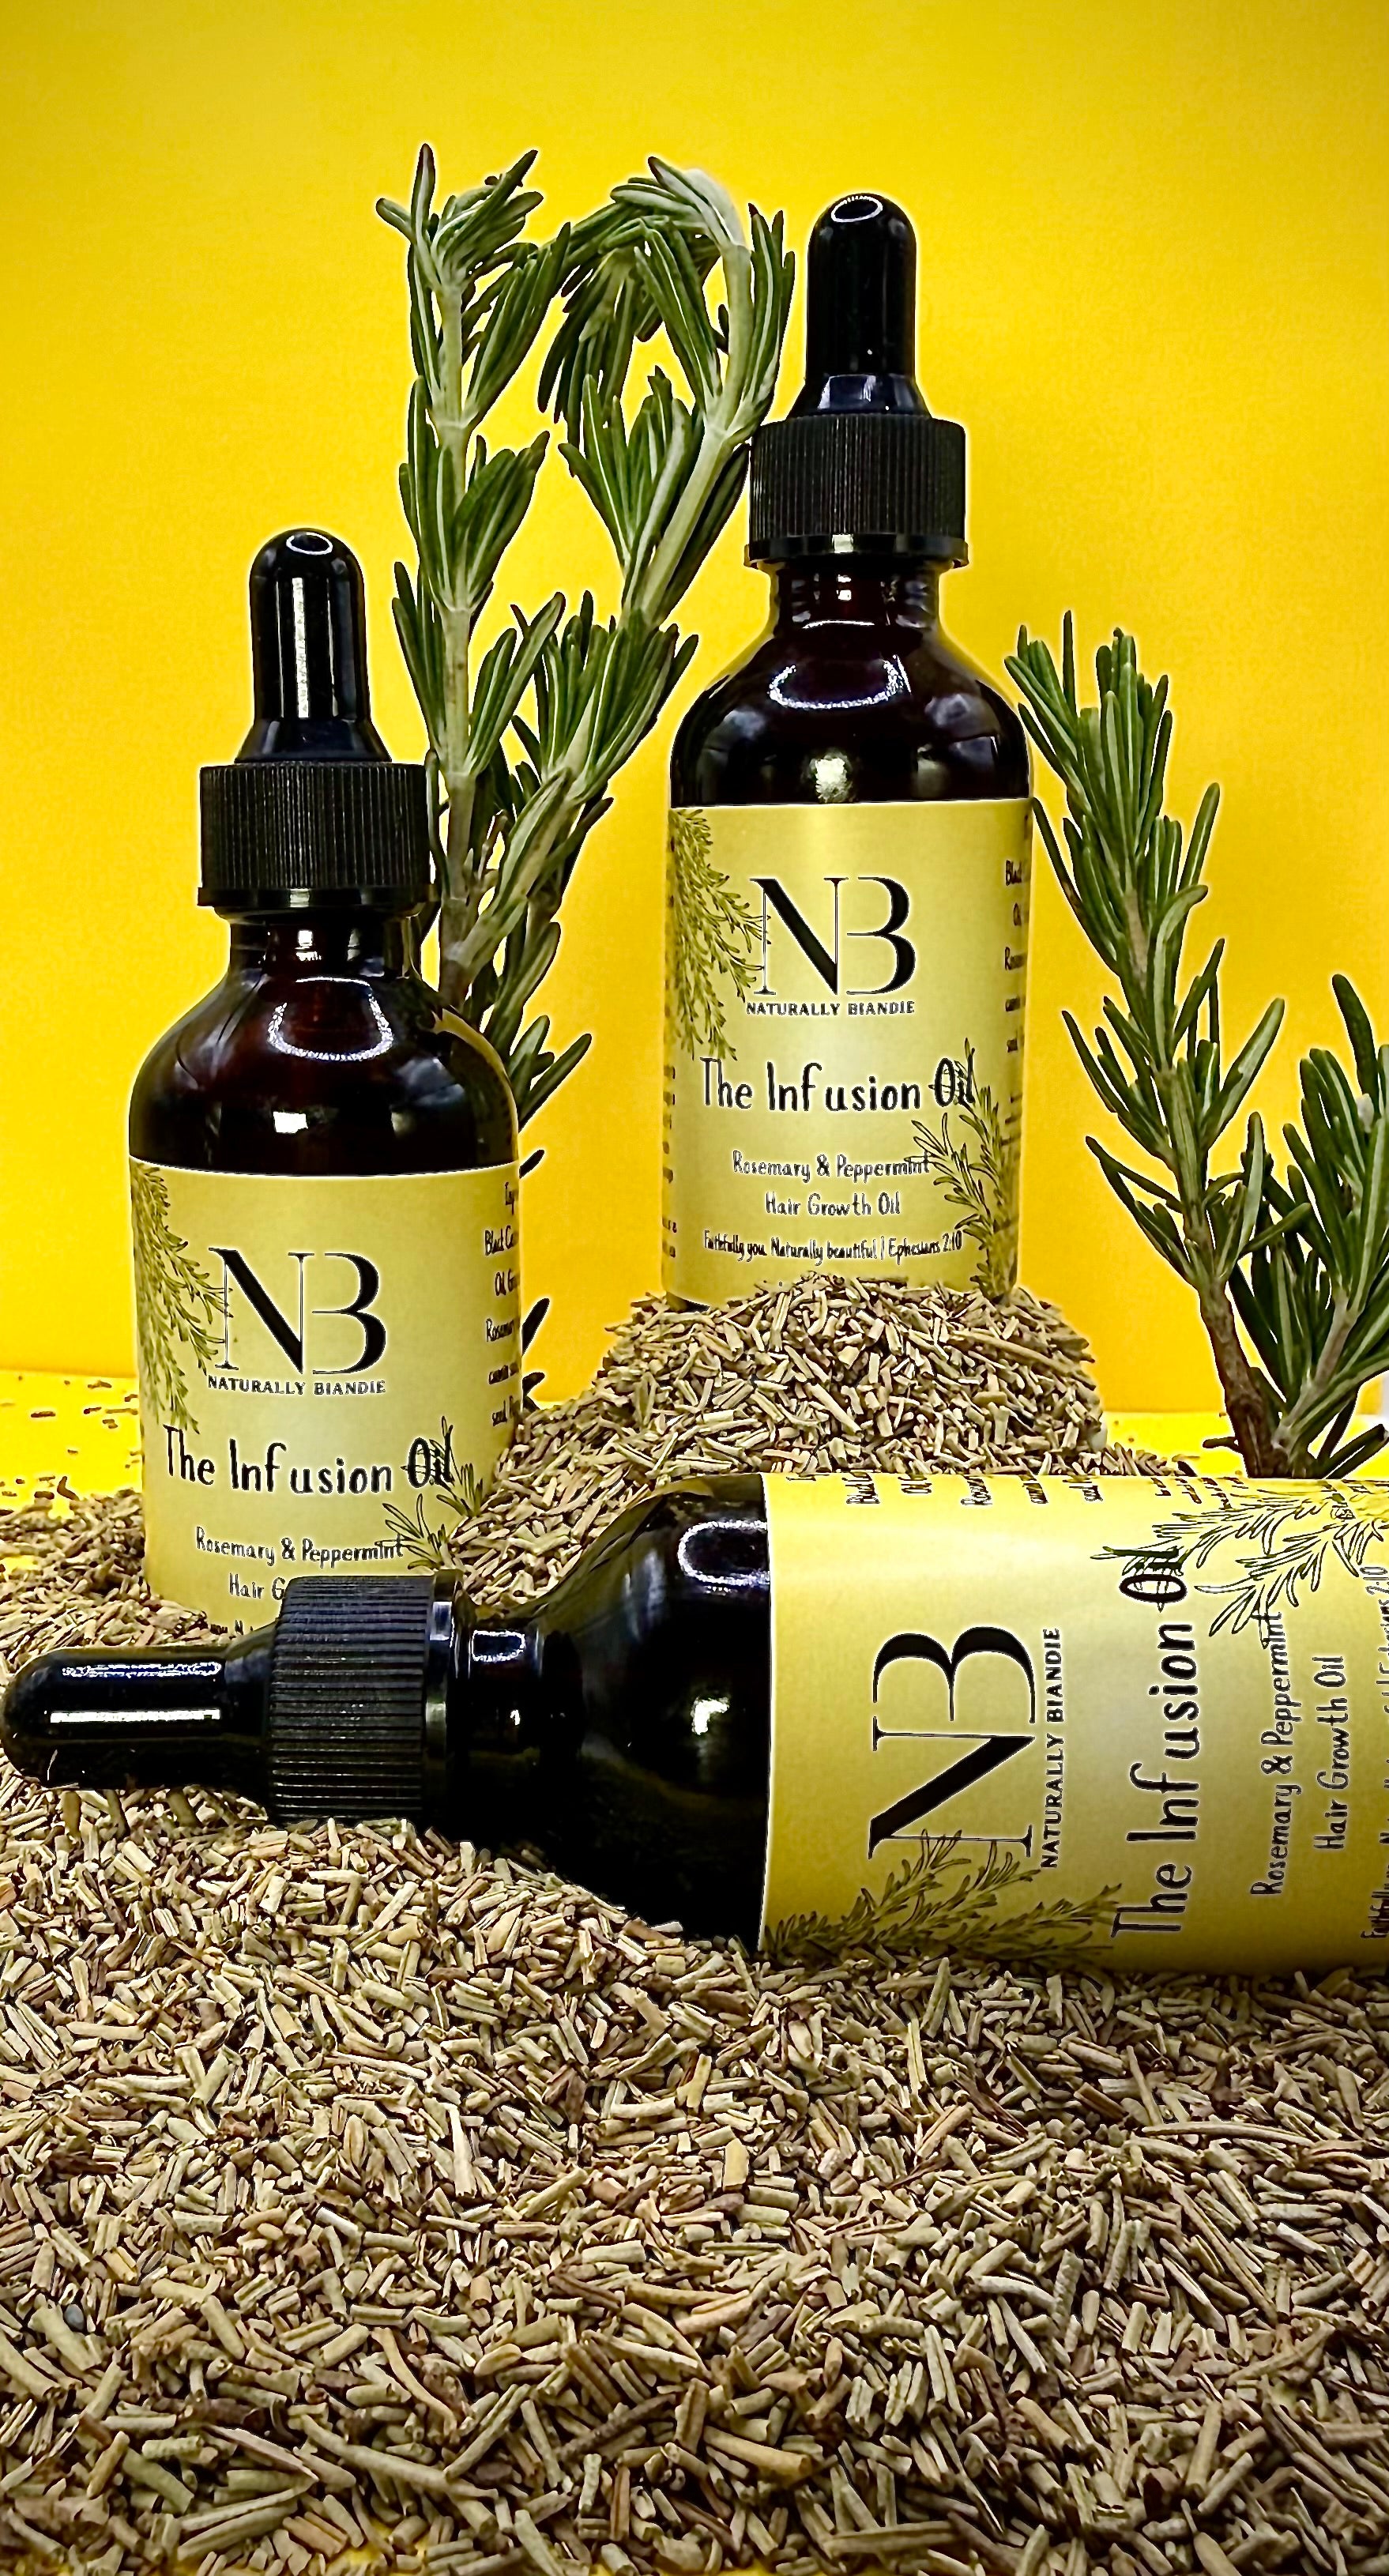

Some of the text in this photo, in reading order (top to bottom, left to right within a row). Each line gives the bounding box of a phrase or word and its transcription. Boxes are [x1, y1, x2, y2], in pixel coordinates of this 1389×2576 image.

[750, 876, 917, 996] NB
[746, 1000, 916, 1017] NATURALLY BIANDIE
[700, 1053, 976, 1112] The Infusion Oil
[732, 1150, 931, 1184] Rosemary & Peppermint
[766, 1191, 901, 1216] Hair Growth Oil
[704, 1230, 745, 1262] Faithfully
[770, 1237, 823, 1267] Naturally
[826, 1239, 878, 1260] beautiful
[888, 1237, 941, 1266] Ephesians
[208, 1247, 386, 1375] NB
[208, 1374, 386, 1396] NATURALLY BIANDIE
[163, 1425, 453, 1494] The Infusion Oil
[196, 1526, 405, 1569] Rosemary & Peppermint
[229, 1572, 265, 1599] Hair
[868, 1626, 1036, 1859] NB
[1041, 1628, 1064, 1870] NATURALLY BIANDIE
[1111, 1548, 1200, 1939] The Infusion Oil
[1250, 1610, 1302, 1896] Rosemary & Peppermint
[1312, 1655, 1349, 1850] Hair Growth Oil
